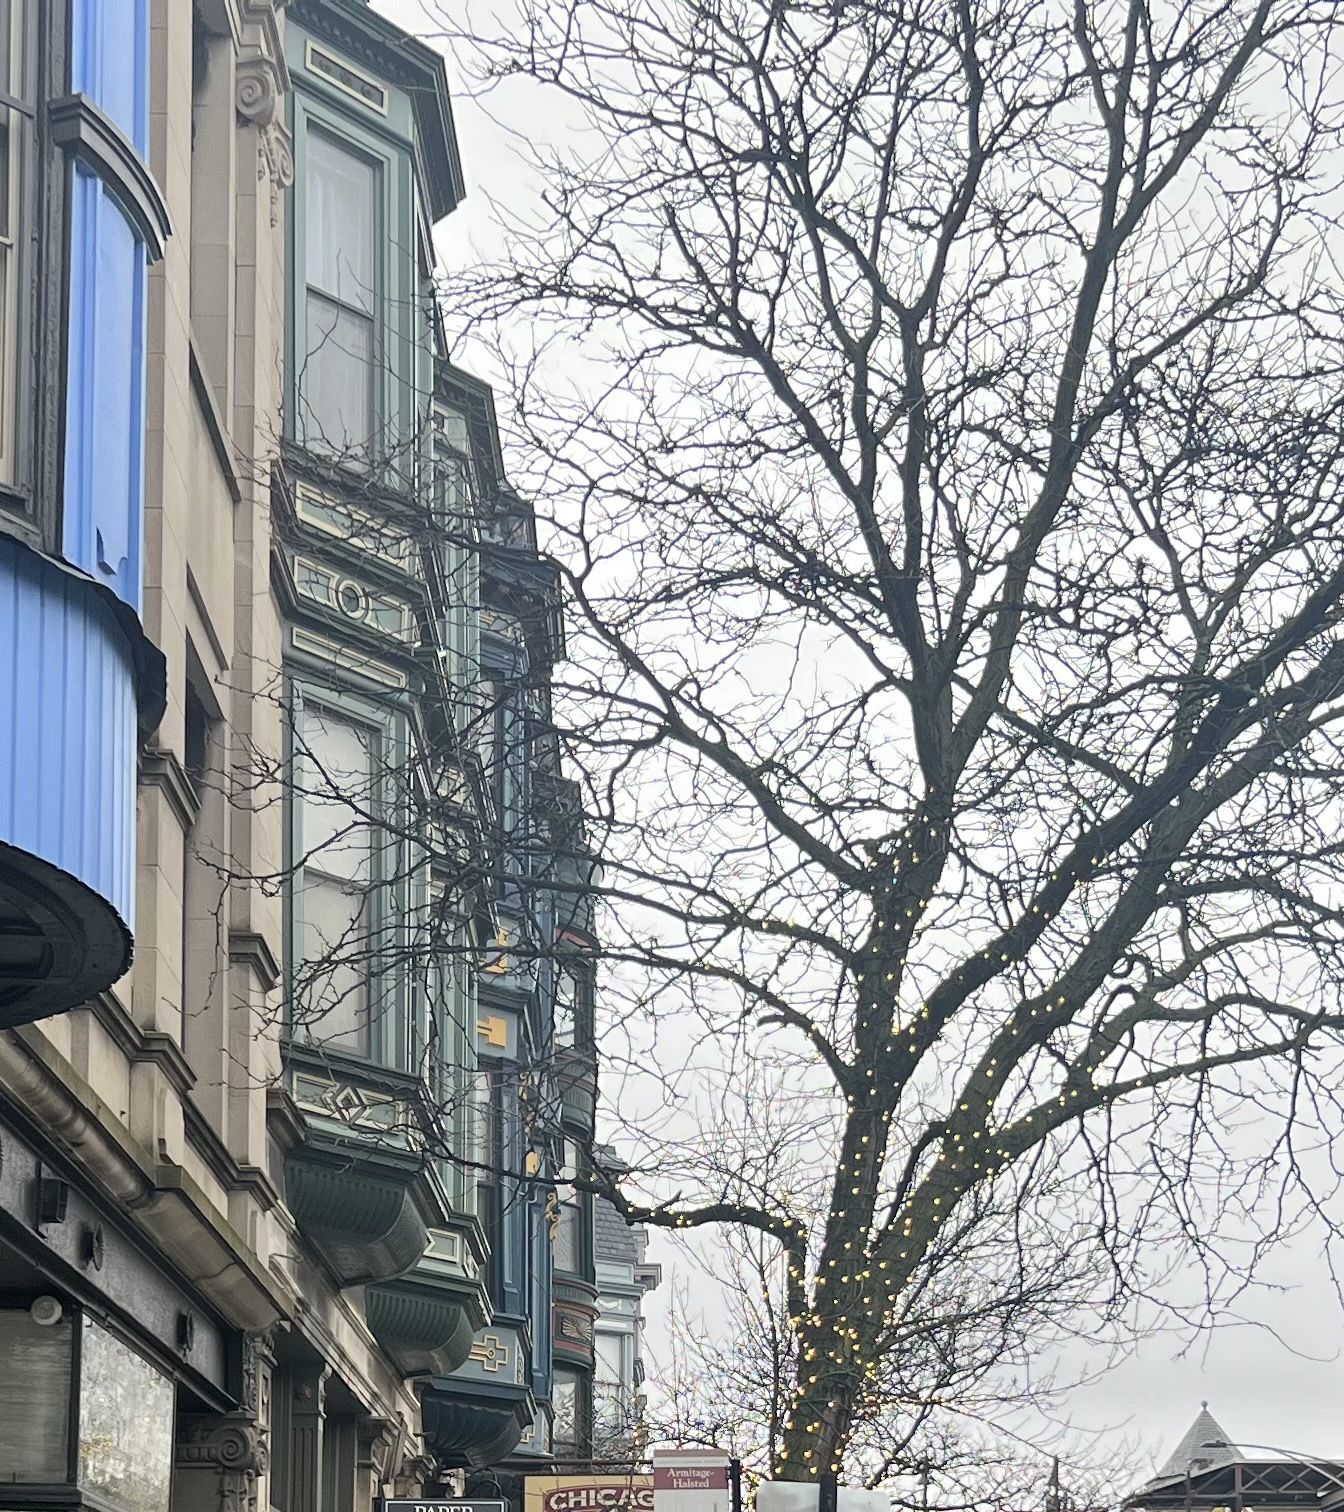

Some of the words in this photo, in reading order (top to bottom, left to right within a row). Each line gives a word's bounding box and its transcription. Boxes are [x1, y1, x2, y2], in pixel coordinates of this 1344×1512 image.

[666, 1467, 715, 1478] Armitage-
[673, 1477, 710, 1488] Halsted
[549, 1488, 654, 1510] CHICAG
